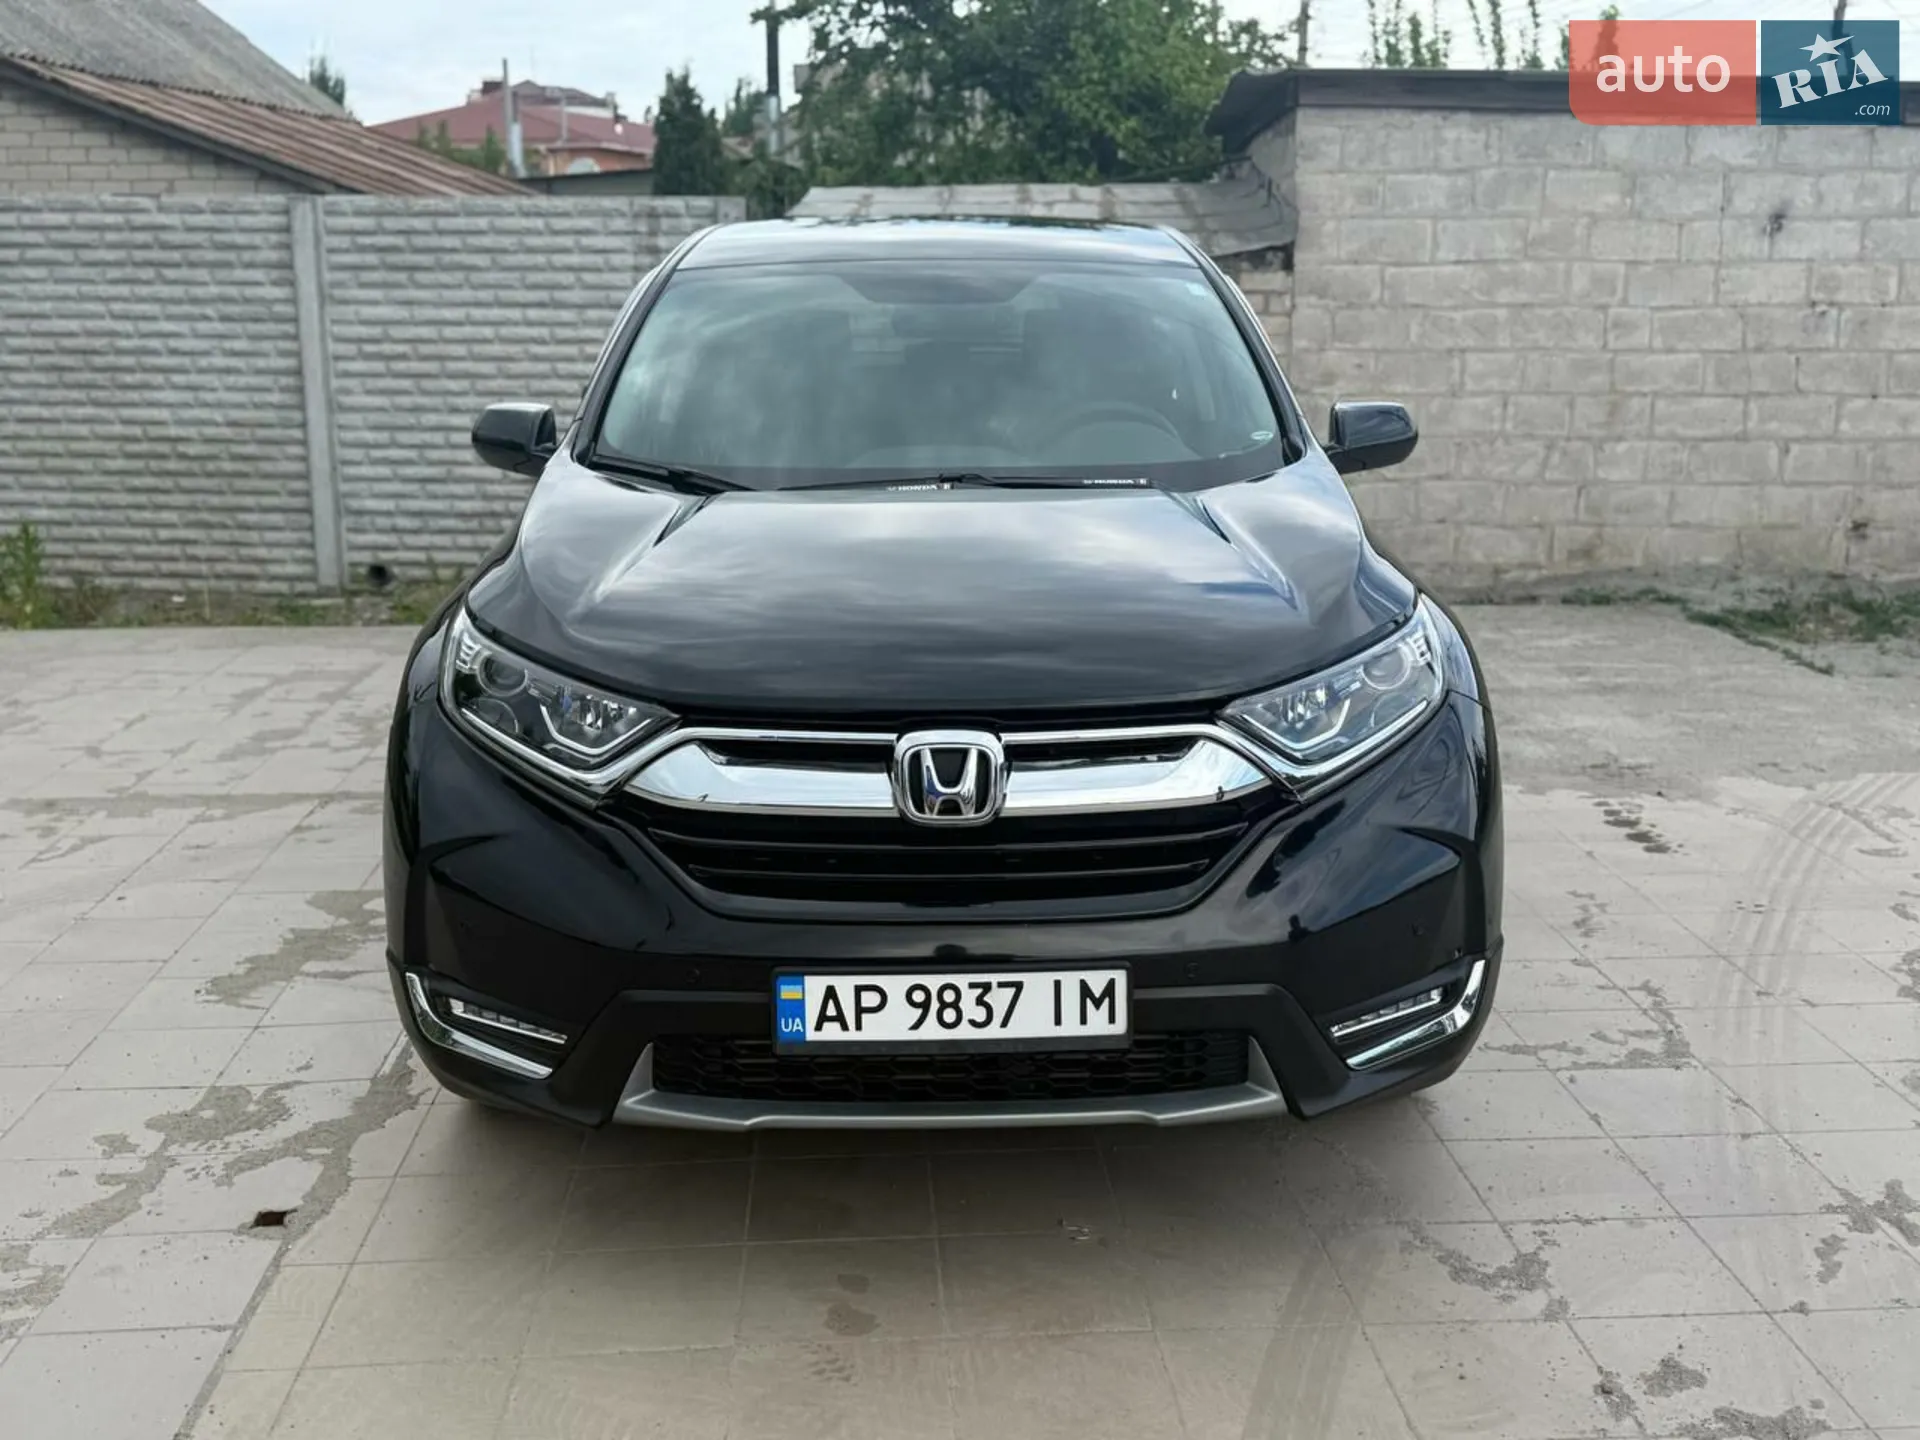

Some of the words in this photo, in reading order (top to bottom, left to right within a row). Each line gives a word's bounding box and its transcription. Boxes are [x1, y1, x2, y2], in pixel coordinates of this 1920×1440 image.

[814, 984, 889, 1032] AP
[905, 980, 1025, 1032] 9837
[781, 1018, 804, 1033] UA
